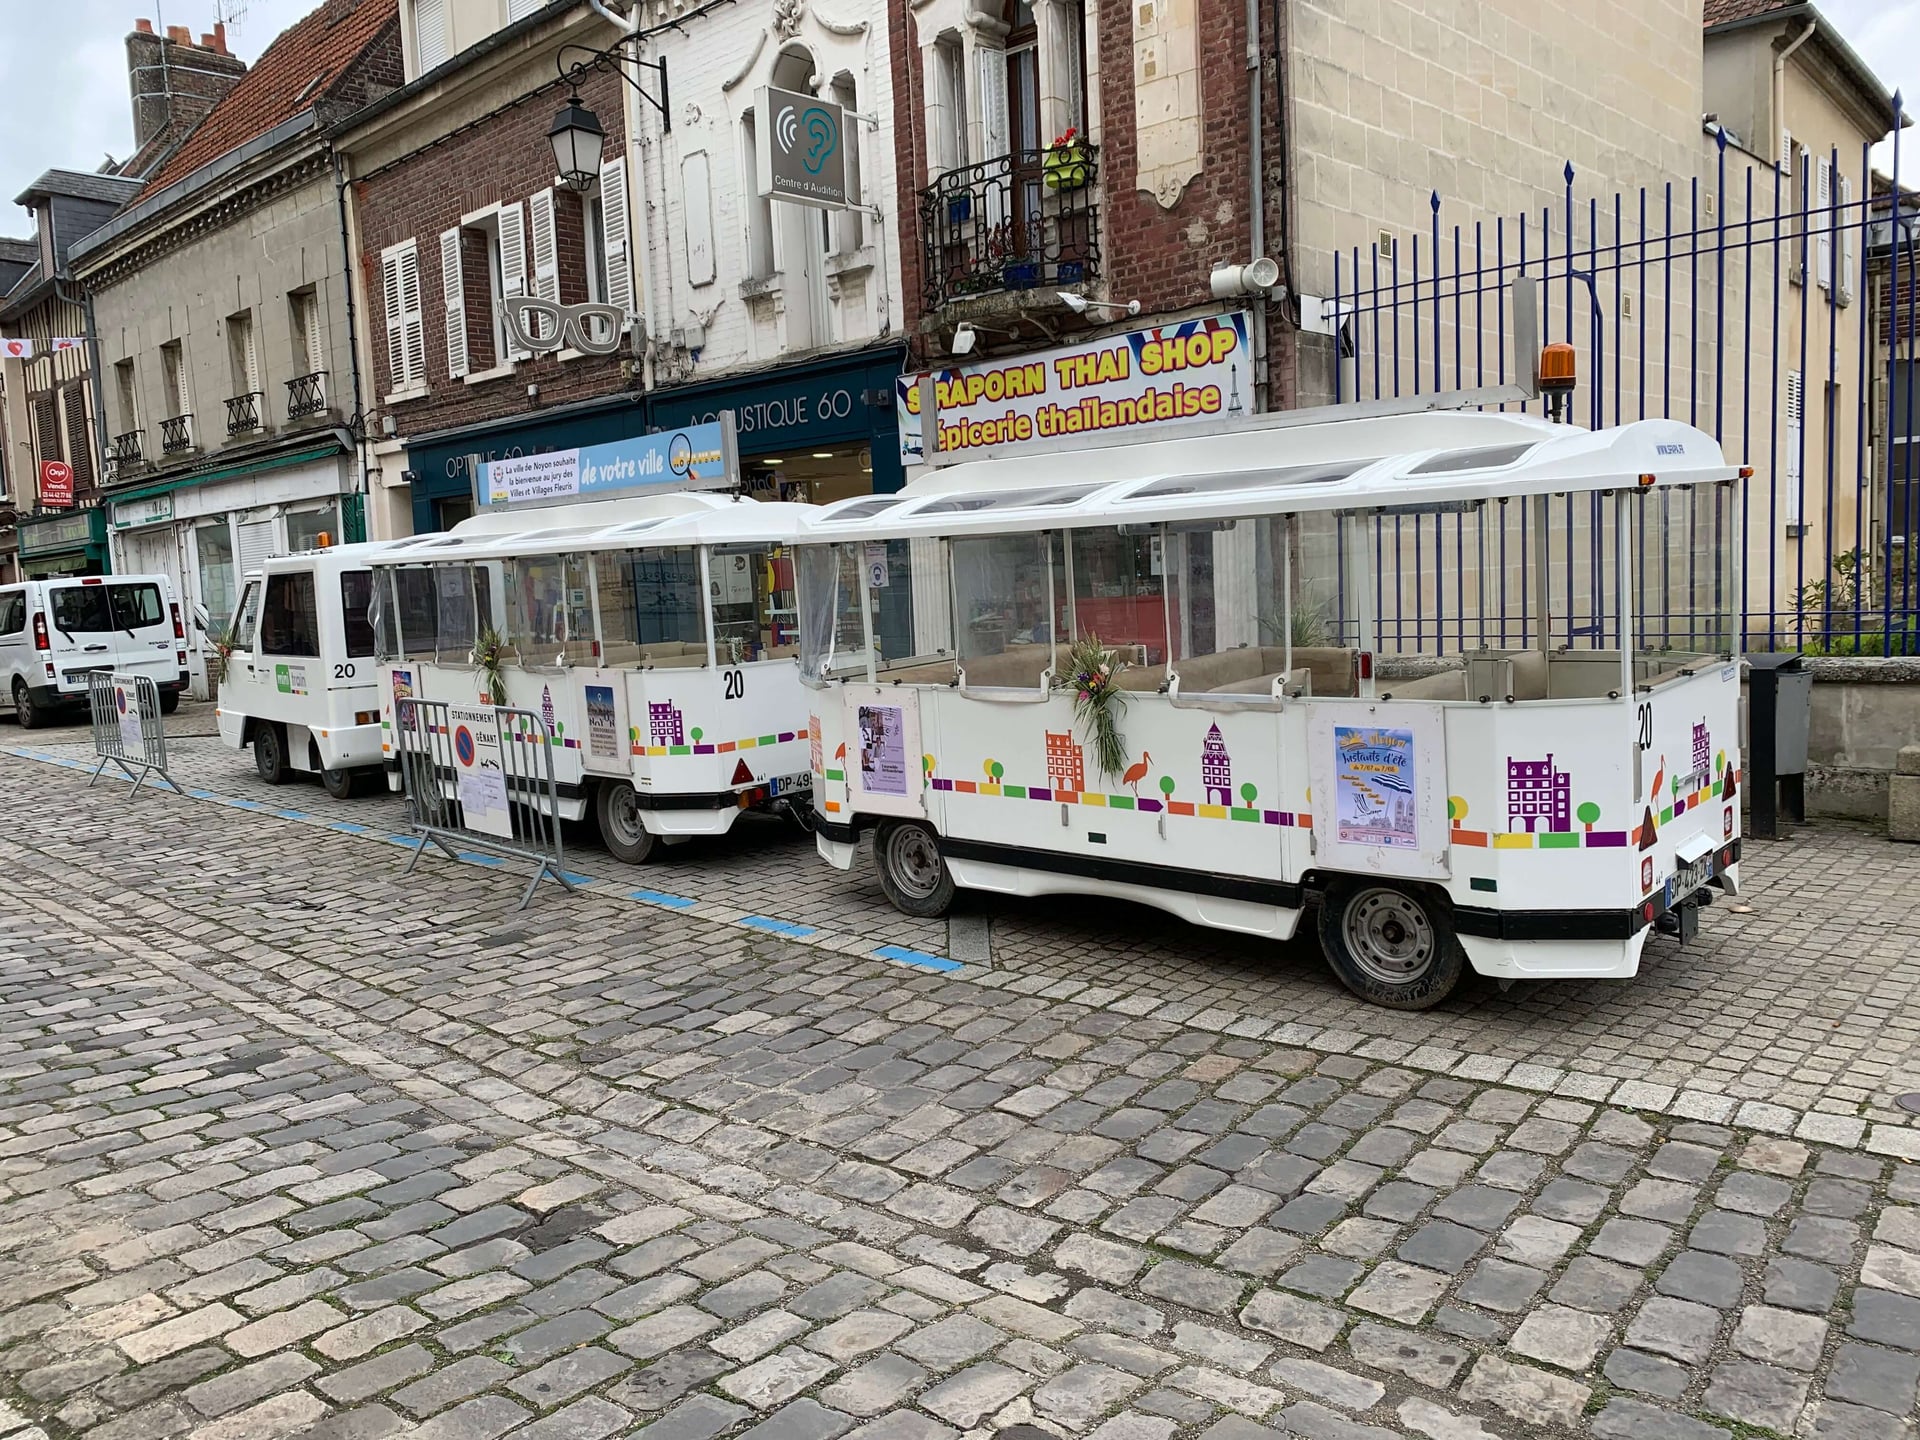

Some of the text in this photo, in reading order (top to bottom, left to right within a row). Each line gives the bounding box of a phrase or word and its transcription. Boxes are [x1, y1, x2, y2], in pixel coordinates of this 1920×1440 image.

[775, 174, 843, 198] Centre d'Audition
[906, 327, 1237, 415] SRAPORN THAI SHOP
[690, 389, 852, 433] ACUSTIQUE 60
[1037, 384, 1221, 437] thaïlandaise
[48, 468, 66, 477] Orpi
[505, 456, 576, 475] La ville de Noyon souhaite
[581, 447, 664, 486] de votre ville
[509, 469, 574, 486] la bienvenue au jury des
[510, 481, 573, 498] Villes et Villages Fleuris
[334, 663, 356, 679] 20
[723, 669, 744, 700] 20
[451, 710, 495, 723] STATIONNEMENT
[1637, 701, 1652, 751] 20
[475, 731, 497, 743] GÊNANT
[1342, 750, 1380, 764] Instants
